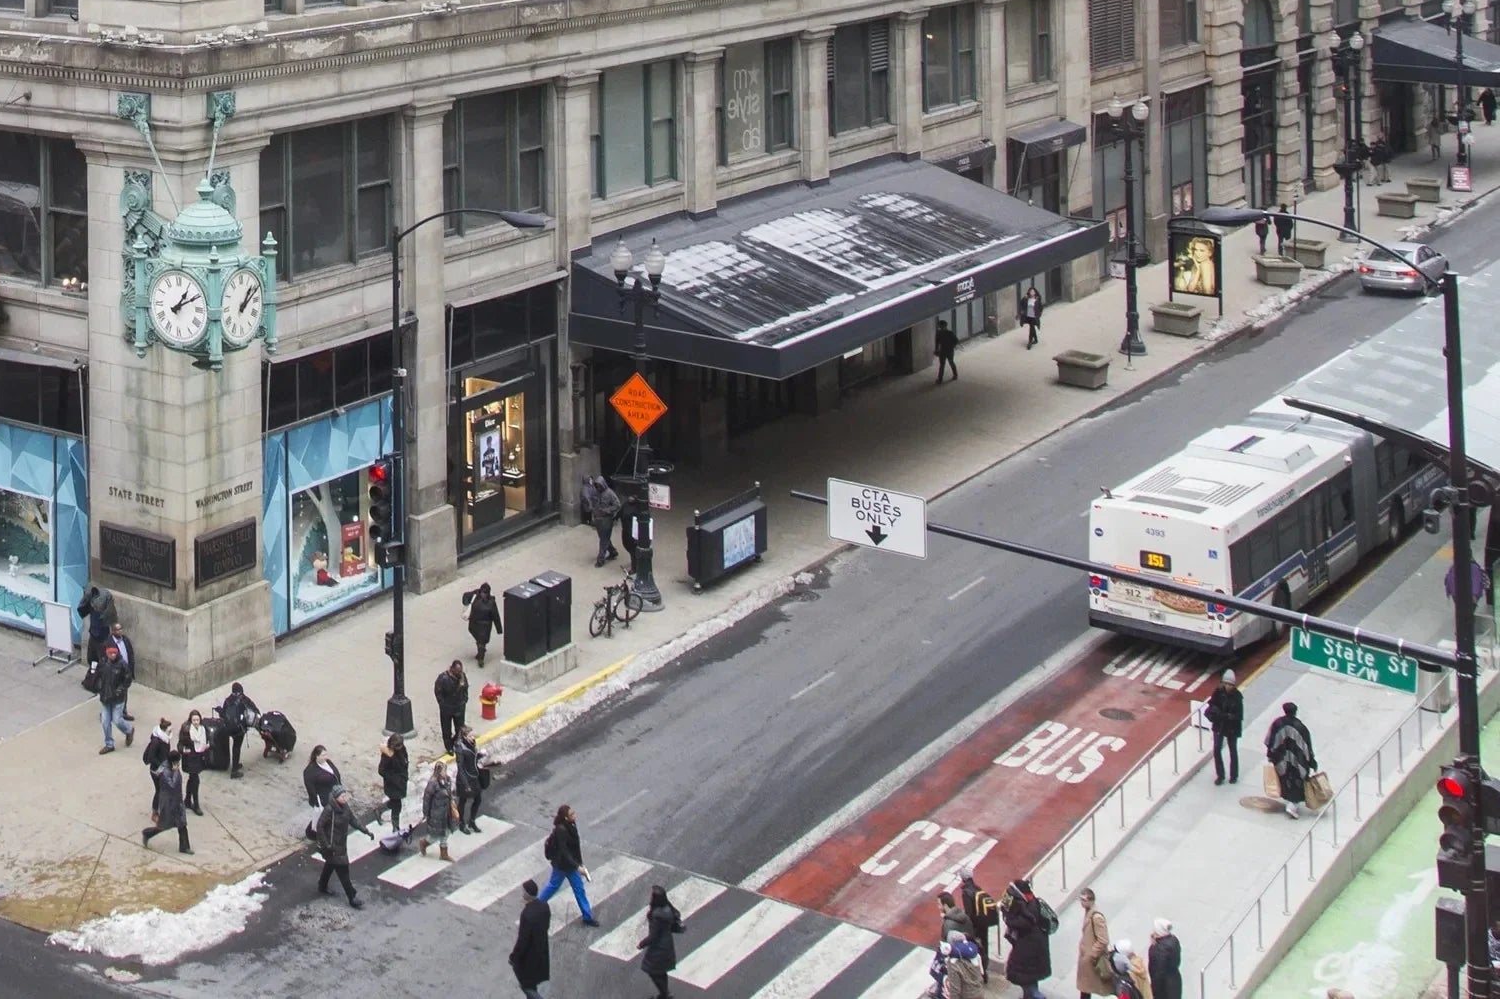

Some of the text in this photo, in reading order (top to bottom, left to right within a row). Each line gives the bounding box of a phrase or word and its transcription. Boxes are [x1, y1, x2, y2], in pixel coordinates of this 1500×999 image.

[108, 486, 165, 508] STATE STREET
[195, 481, 254, 509] WASHINGTON STREET
[862, 488, 891, 504] CTA
[851, 497, 902, 518] BUSES
[855, 510, 897, 527] ONLY
[1145, 527, 1166, 538] 4393
[1147, 553, 1165, 568] 151
[1299, 630, 1409, 677] N State St
[1346, 661, 1379, 682] E/W
[992, 720, 1127, 784] BUS
[859, 820, 999, 893] CTA
